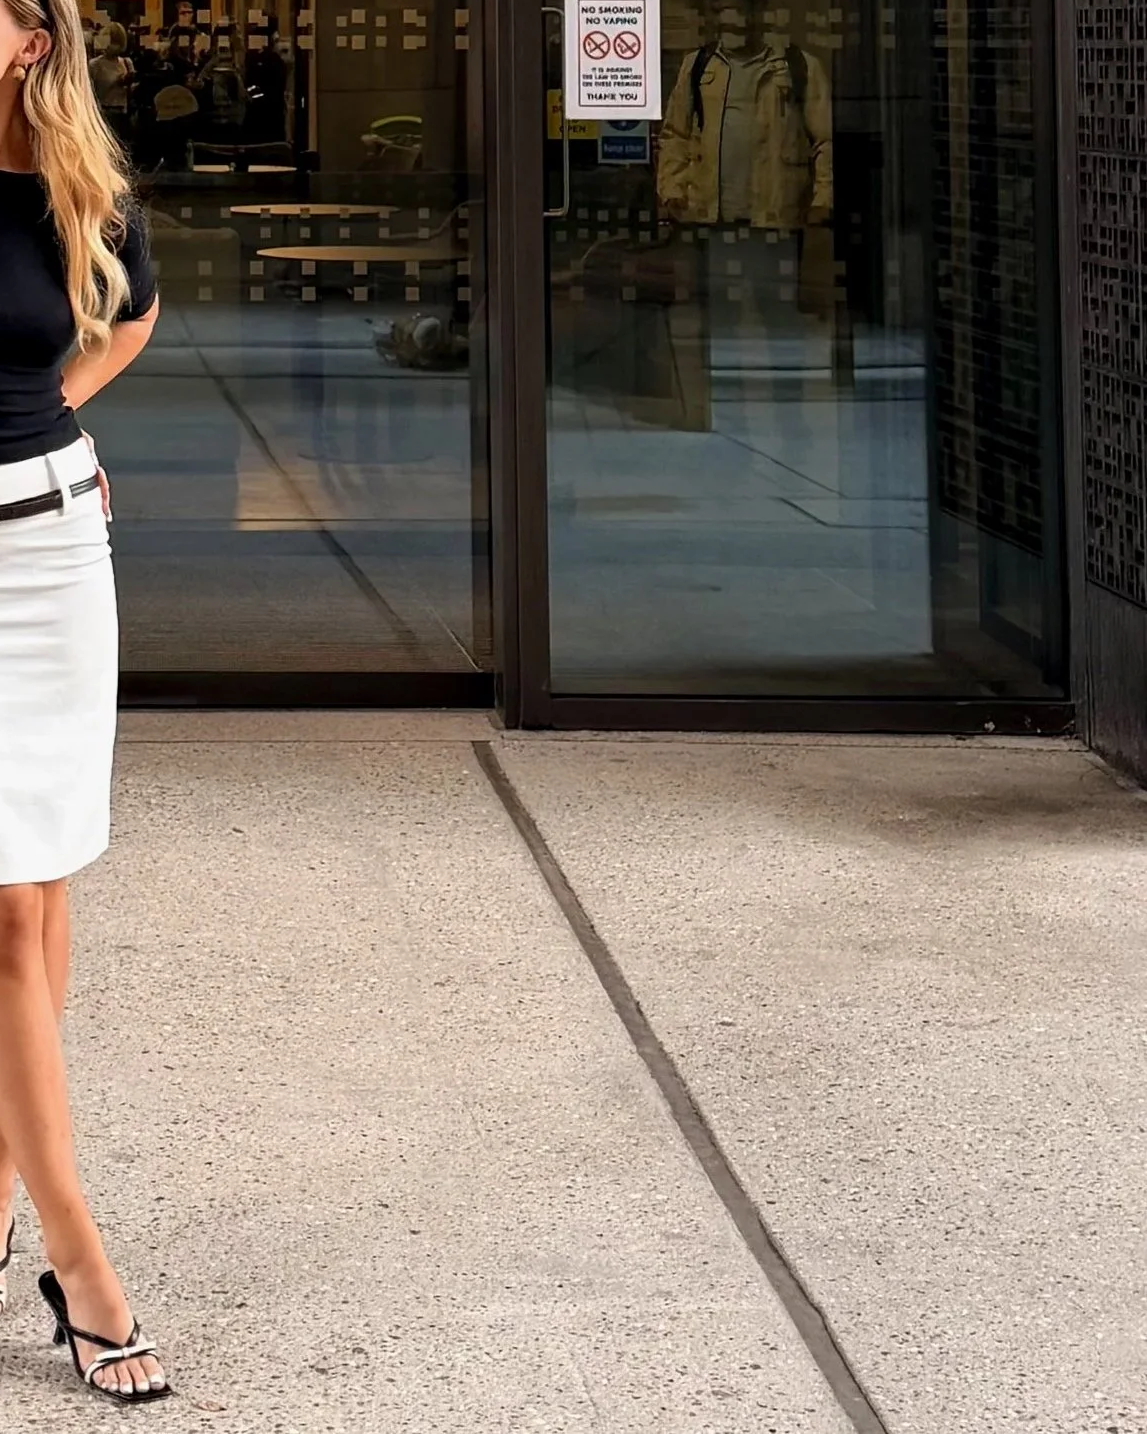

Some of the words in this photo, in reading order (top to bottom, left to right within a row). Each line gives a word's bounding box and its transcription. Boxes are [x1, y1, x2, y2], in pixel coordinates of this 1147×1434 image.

[581, 6, 596, 14] NO
[598, 6, 643, 14] SMOKING
[585, 17, 601, 25] NO
[603, 17, 638, 25] VAPING
[587, 93, 616, 101] THANK
[619, 93, 638, 101] YOU
